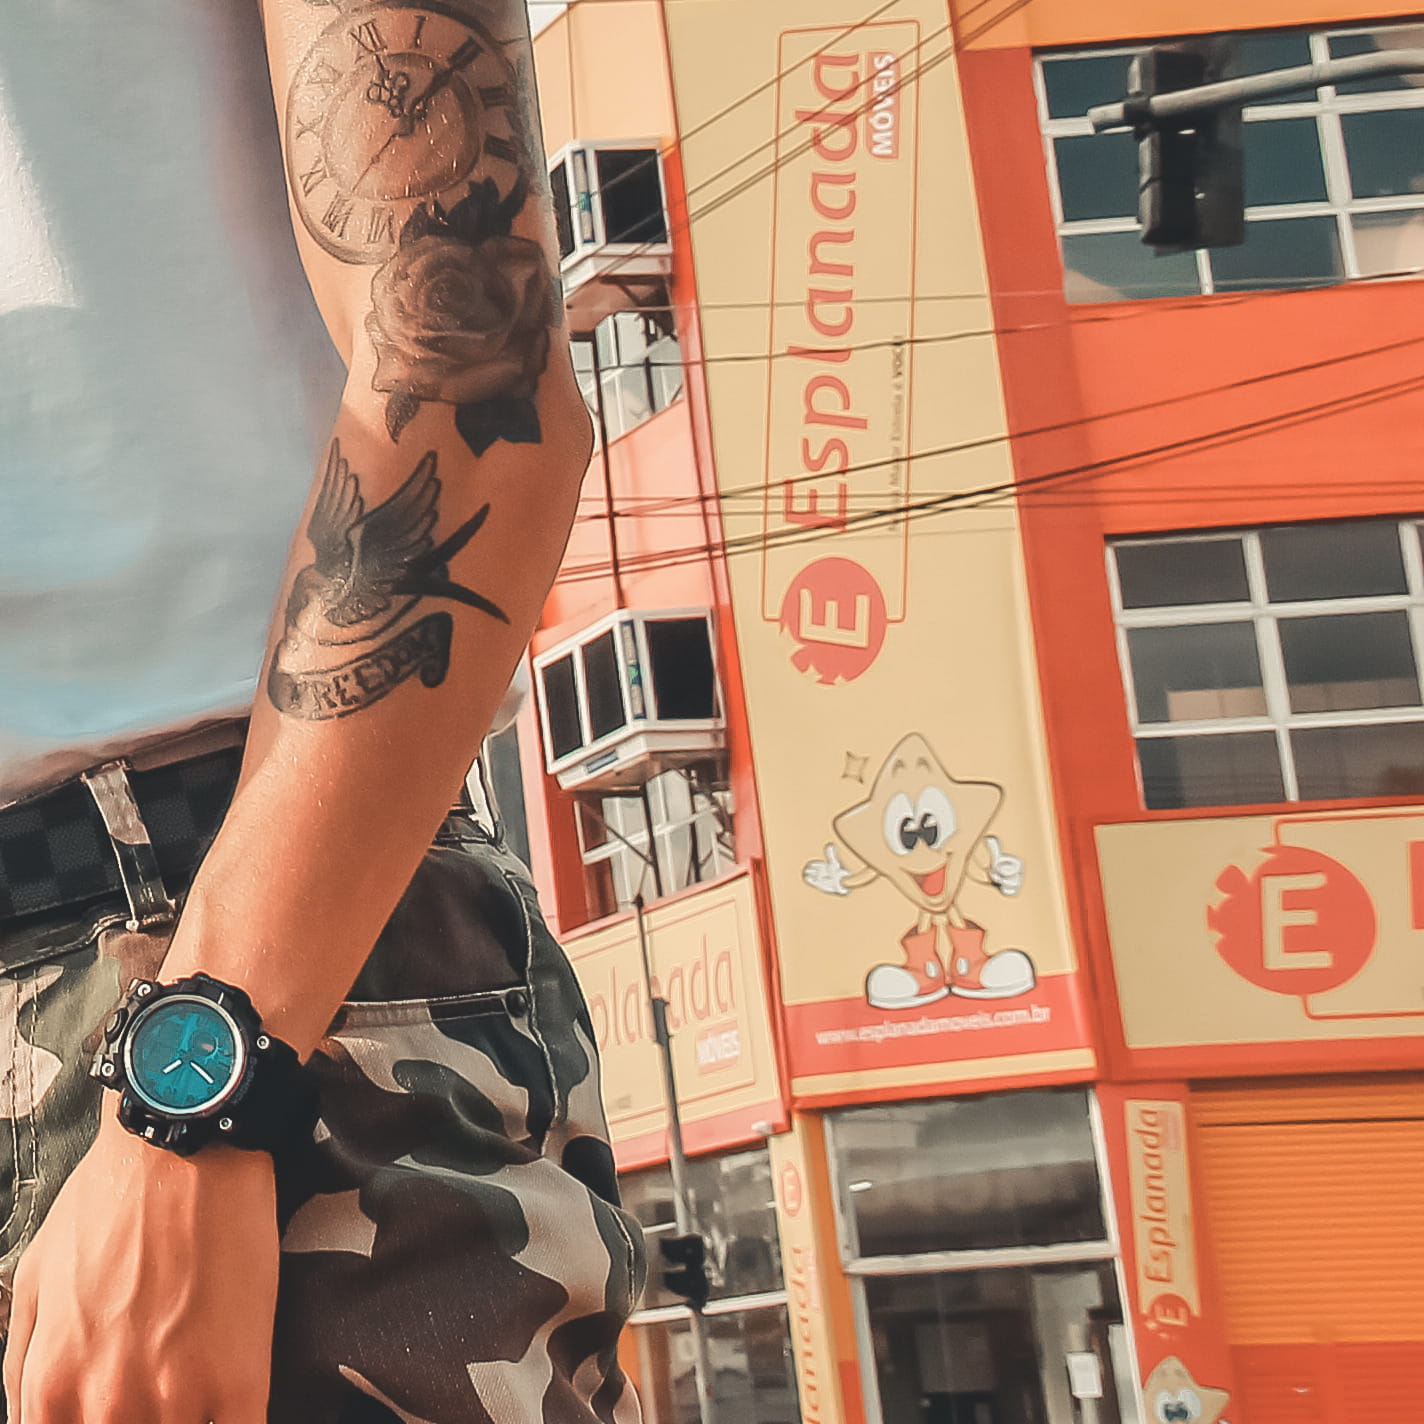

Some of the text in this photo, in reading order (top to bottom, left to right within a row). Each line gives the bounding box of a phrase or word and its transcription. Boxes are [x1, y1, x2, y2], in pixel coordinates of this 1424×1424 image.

[785, 54, 869, 533] Esplanada
[1261, 873, 1333, 971] E
[1133, 1108, 1177, 1283] Esplanada
